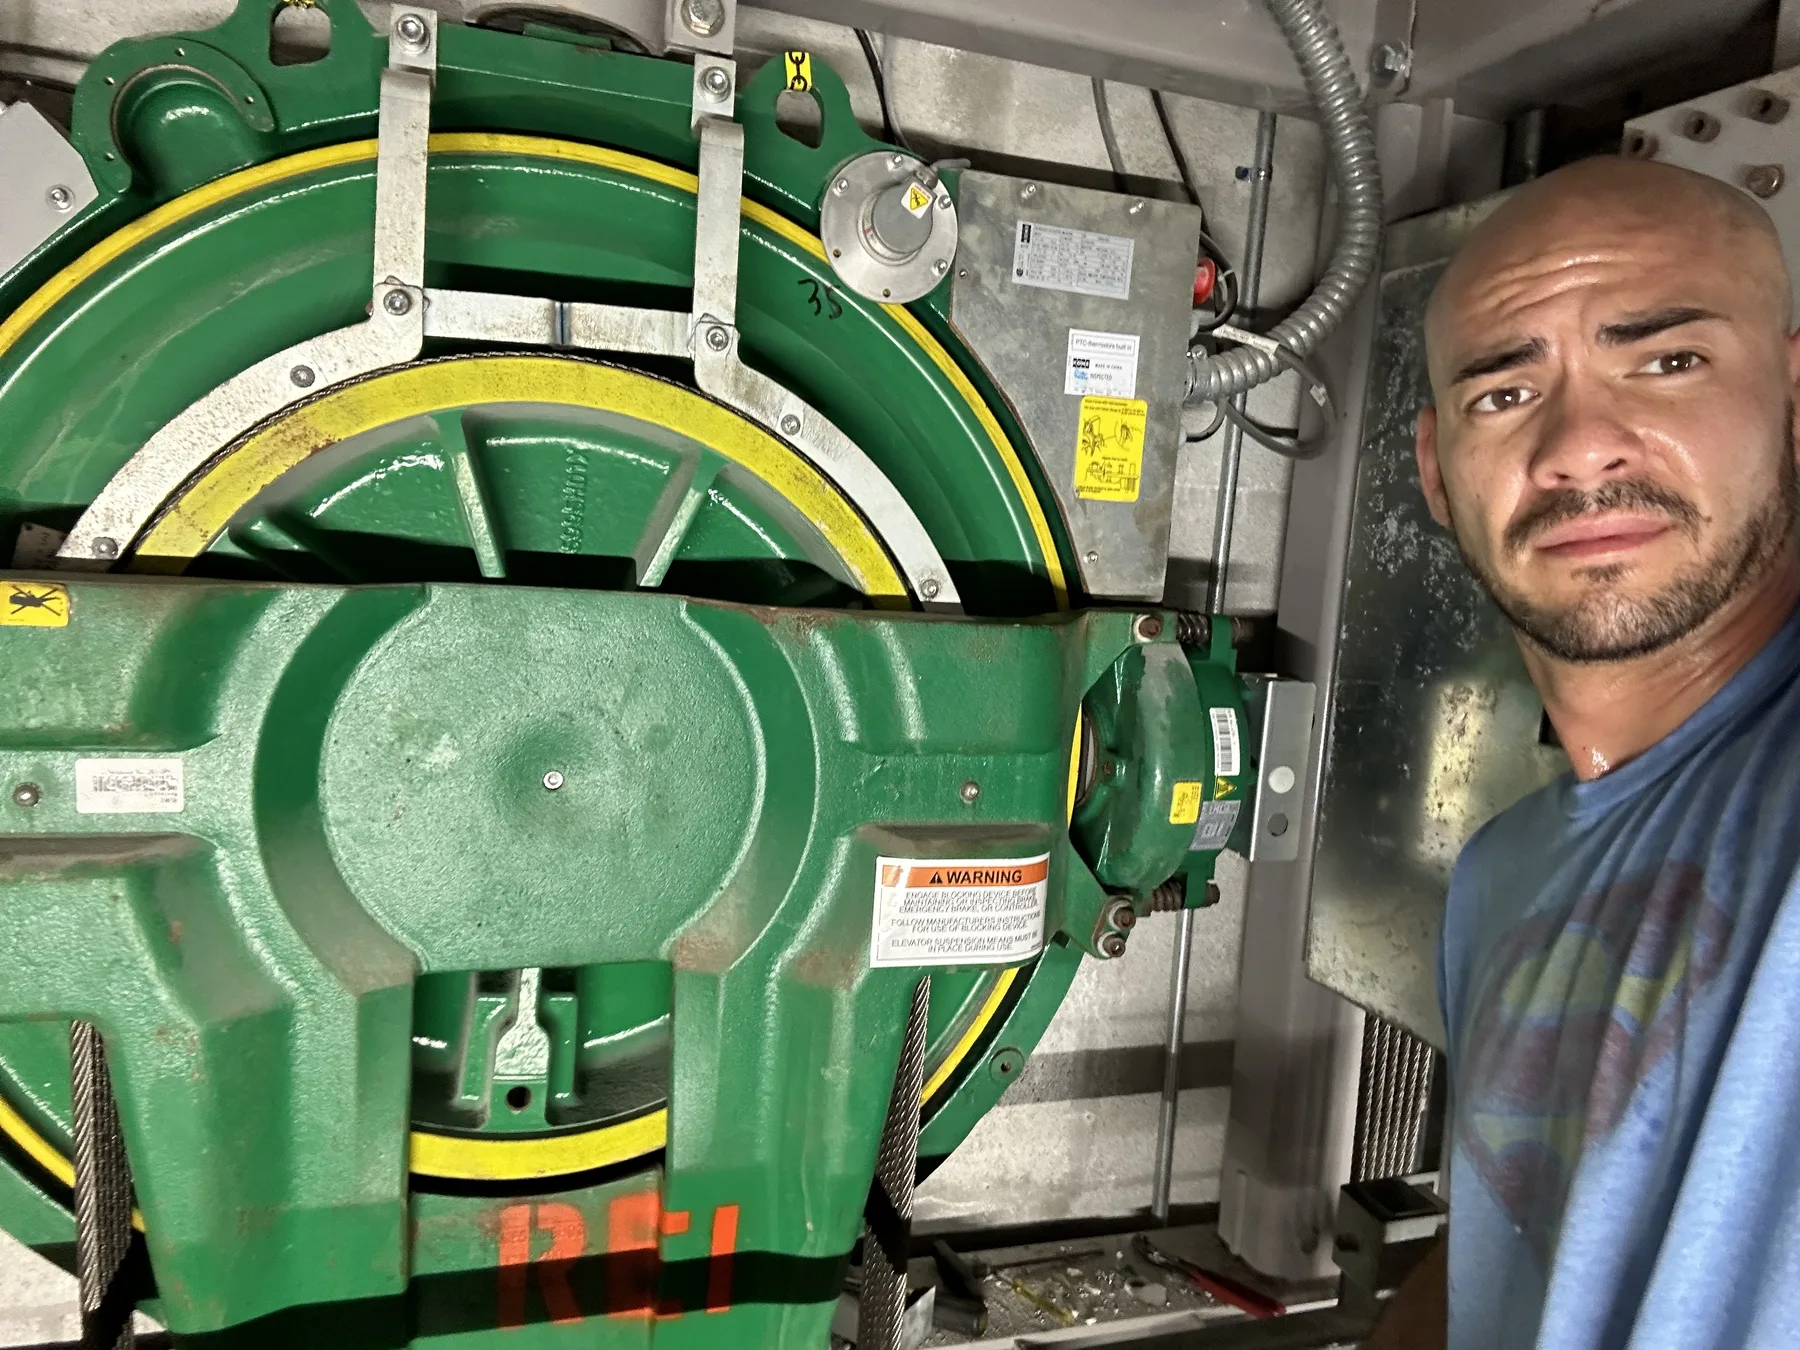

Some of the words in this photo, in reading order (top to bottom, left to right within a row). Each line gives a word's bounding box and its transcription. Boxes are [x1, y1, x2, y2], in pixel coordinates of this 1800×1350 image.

[946, 870, 1022, 884] WARNING
[906, 890, 939, 899] ENGAGE
[941, 889, 981, 899] BLOCKING
[982, 889, 1011, 898] DEVICE
[903, 898, 954, 906] MAINTAINING
[899, 905, 949, 914] EMERGENCY
[981, 904, 994, 913] OR
[891, 918, 925, 926] FOLLOW
[912, 925, 931, 933] FOR
[931, 924, 947, 933] USE
[961, 923, 1001, 932] BLOCKING
[891, 938, 933, 947] ELEVATOR
[934, 936, 985, 946] SUSPENSION
[986, 935, 1014, 945] MEANS
[1014, 933, 1031, 943] MUST
[937, 944, 963, 953] PLACE
[964, 943, 995, 952] DURING
